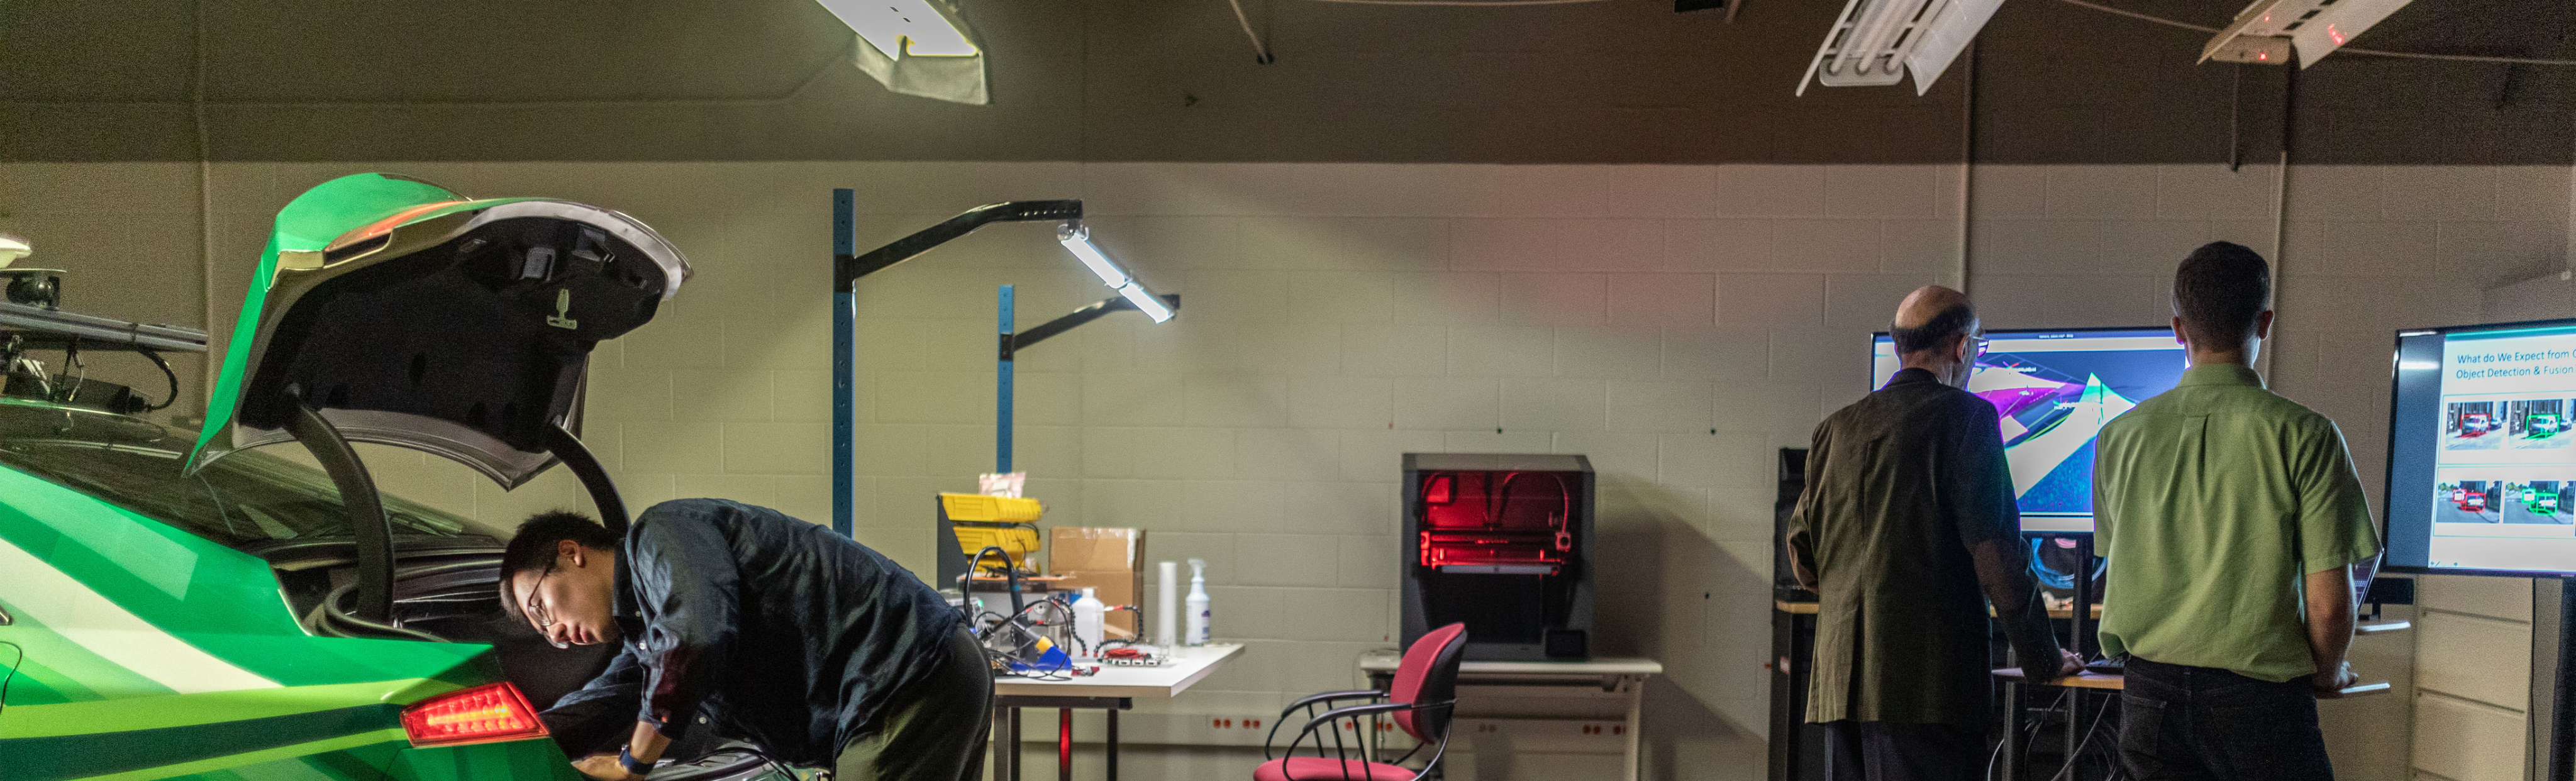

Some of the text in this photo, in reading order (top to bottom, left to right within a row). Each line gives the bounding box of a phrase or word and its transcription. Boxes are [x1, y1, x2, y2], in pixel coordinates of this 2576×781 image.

[2457, 354, 2481, 364] What
[2484, 353, 2495, 363] do
[2497, 352, 2512, 362] We
[2514, 351, 2545, 362] Expect
[2547, 349, 2569, 359] from
[2456, 368, 2485, 380] Object
[2487, 367, 2531, 377] Detection
[2533, 365, 2540, 375] &
[2543, 365, 2573, 375] Fusion
